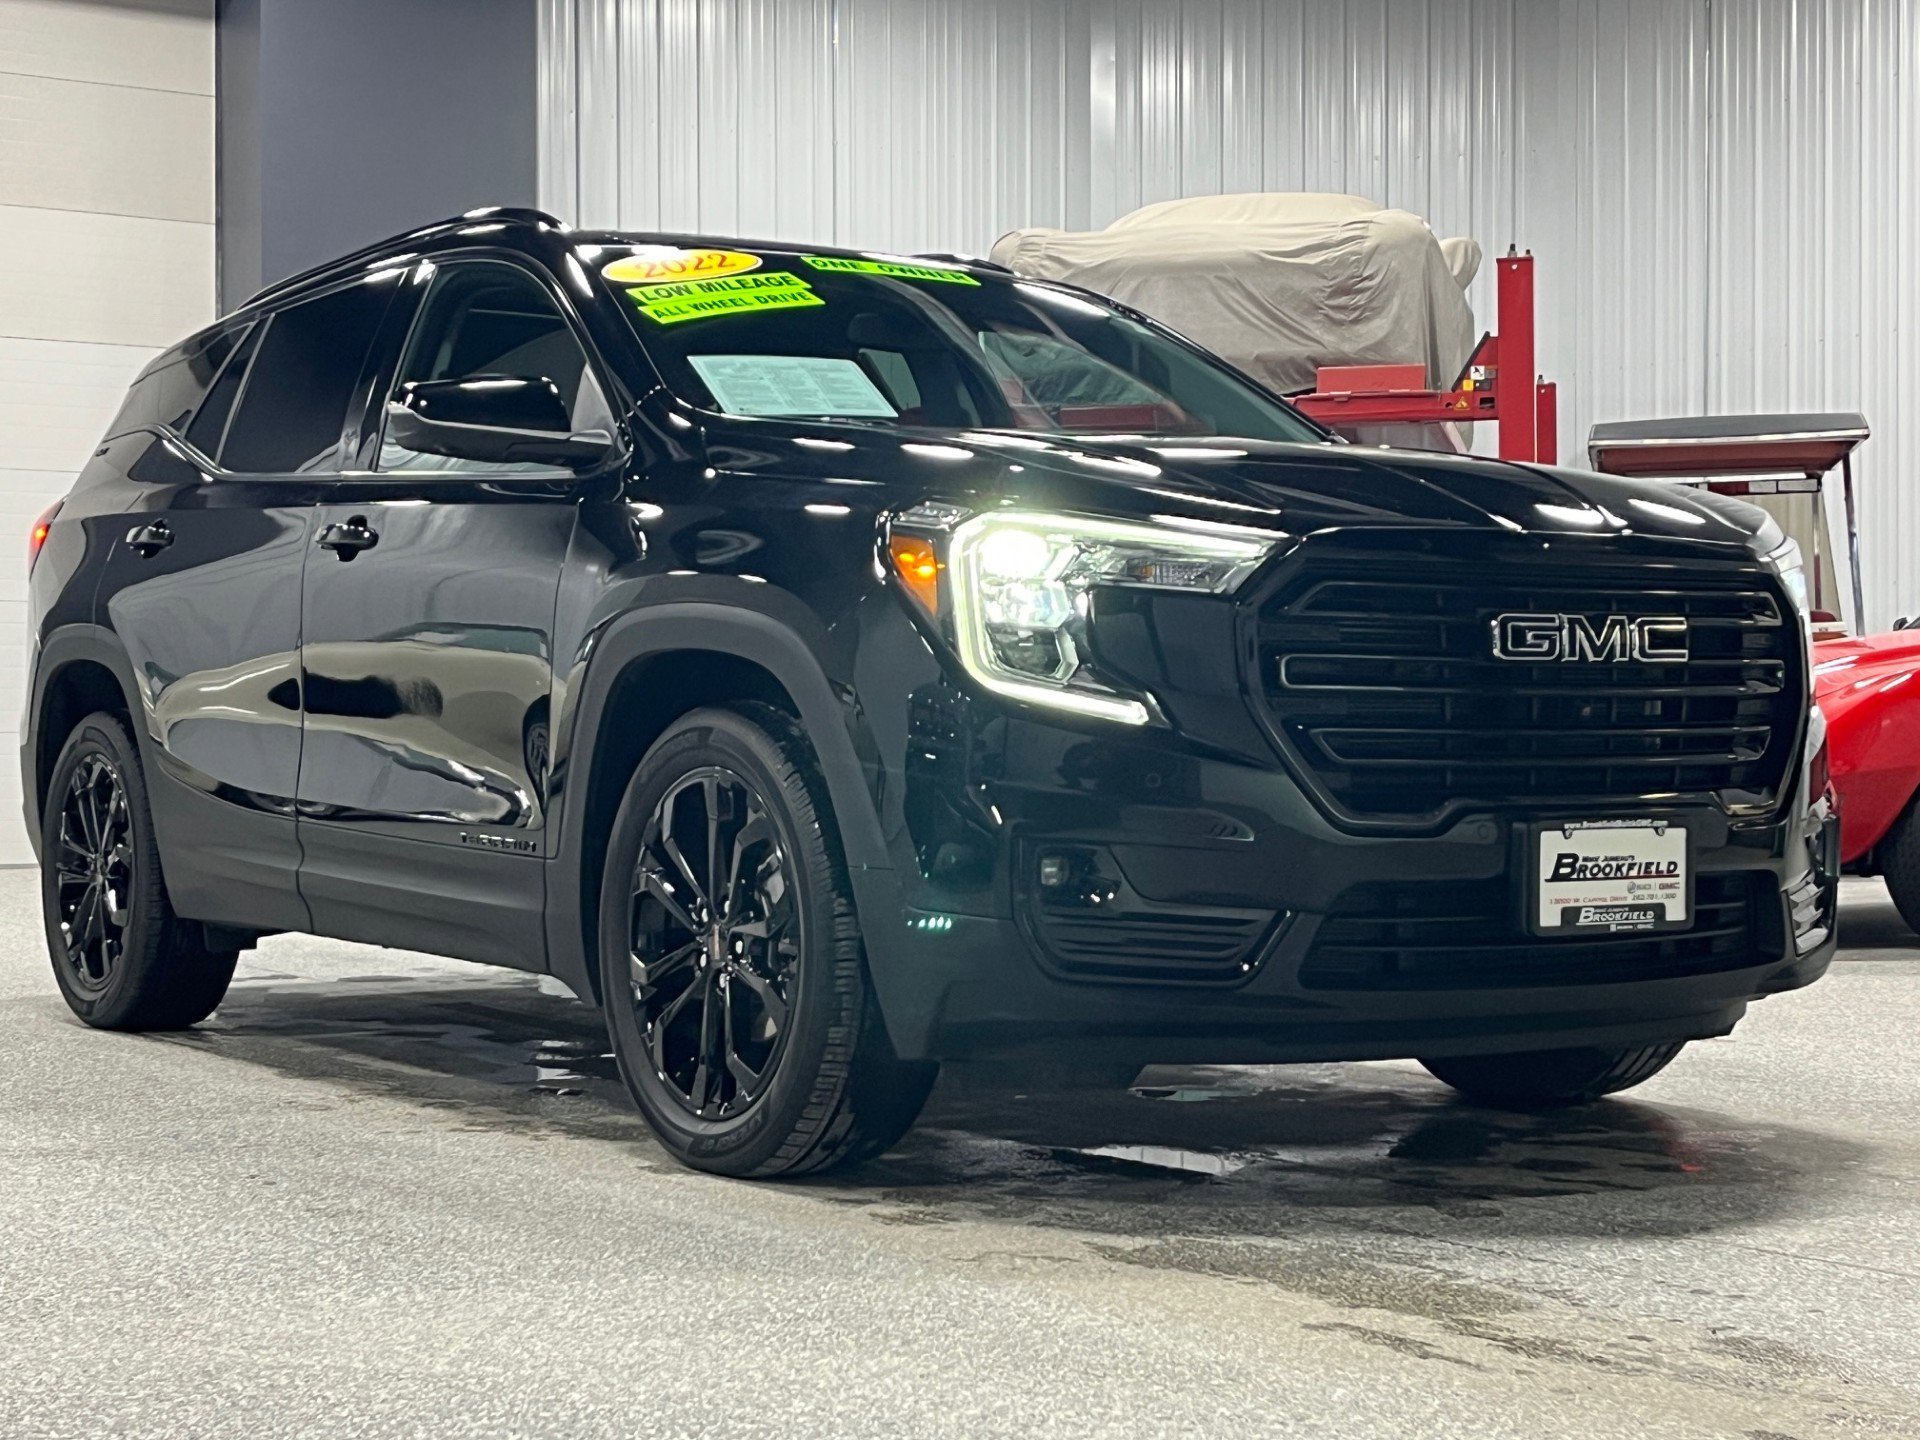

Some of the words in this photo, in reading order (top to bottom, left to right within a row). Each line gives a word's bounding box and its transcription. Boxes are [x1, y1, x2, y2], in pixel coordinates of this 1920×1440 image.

[635, 253, 736, 279] 2022
[811, 258, 859, 270] ONE
[878, 264, 969, 282] OWNER
[638, 284, 693, 302] LOW
[695, 275, 800, 294] MILEAGE
[652, 304, 690, 319] ALL
[692, 297, 747, 312] WHEEL
[753, 291, 814, 305] DRIVE
[1490, 612, 1689, 663] GMC
[1548, 853, 1679, 881] BROOKFIELD
[1578, 906, 1655, 923] BROOKFIELD
